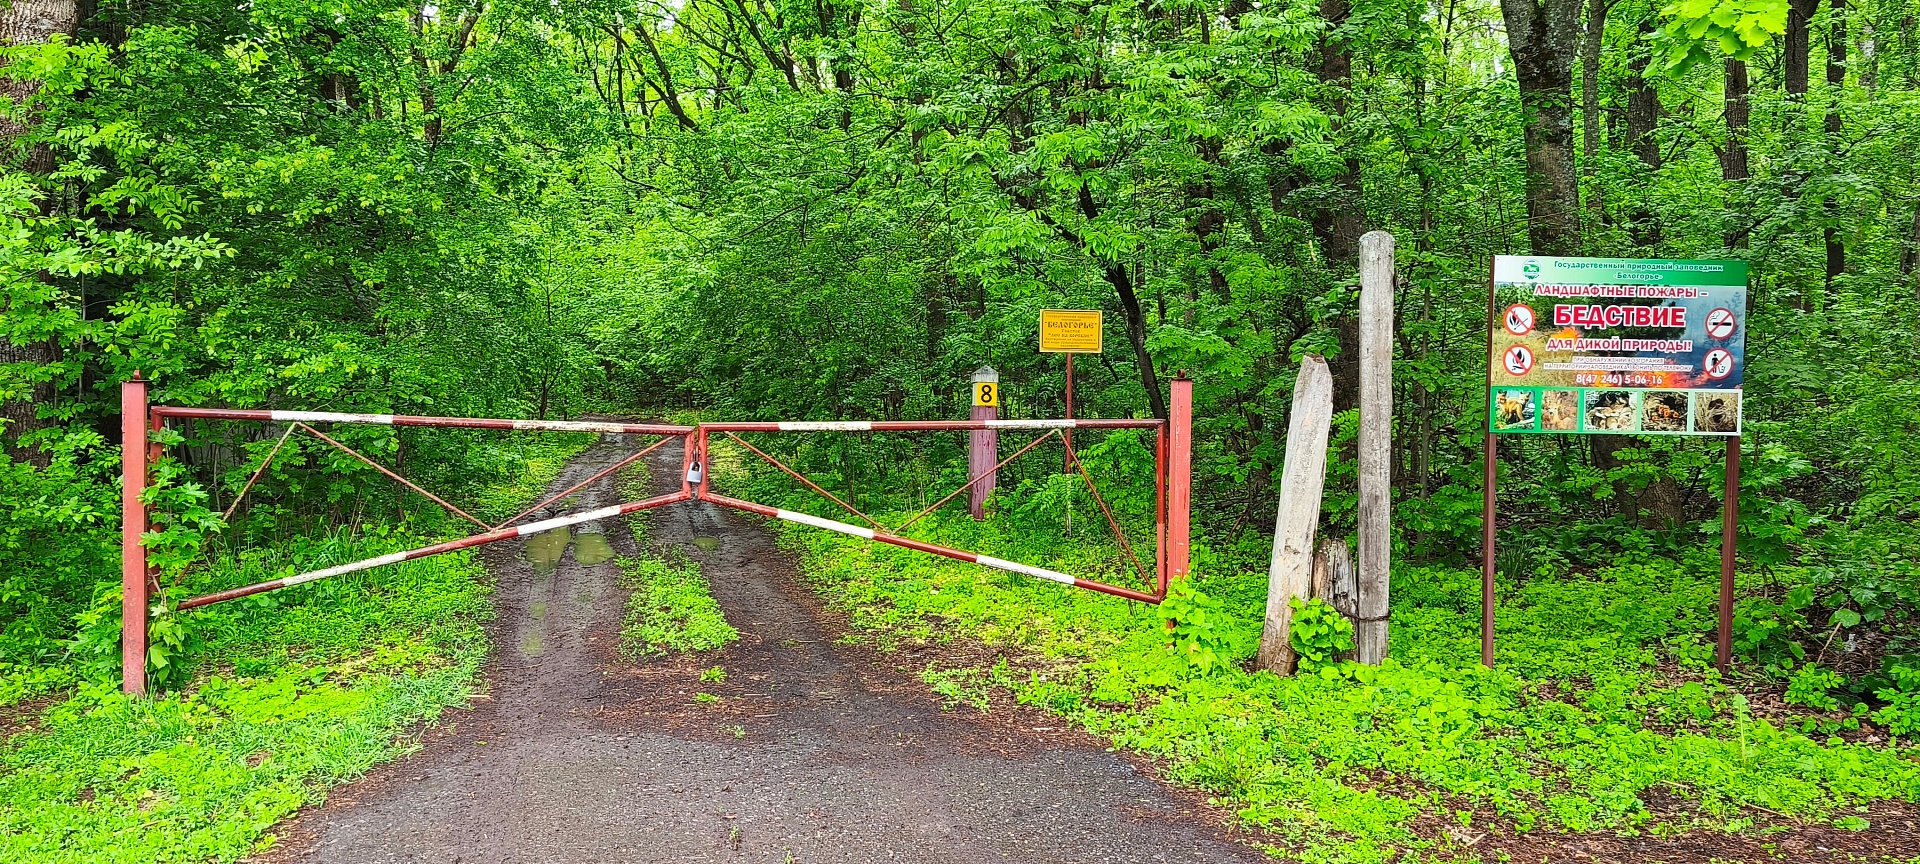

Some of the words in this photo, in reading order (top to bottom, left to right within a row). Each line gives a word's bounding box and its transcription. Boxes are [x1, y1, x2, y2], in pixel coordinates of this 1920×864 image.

[1554, 260, 1625, 269] Государственный
[1627, 262, 1673, 271] природный
[1675, 264, 1723, 272] заповедник
[1535, 285, 1634, 297] ЛАНДШАФТНЫЕ
[1639, 287, 1697, 297] ПОЖАРЫ
[1555, 305, 1685, 328] БЕДСТВИЕ
[1547, 339, 1572, 350] ДЛЯ
[1576, 337, 1620, 350] ДИКОЙ
[1624, 340, 1692, 351] ПРИРОДЫ!
[1576, 373, 1598, 384] 8(47
[1601, 374, 1622, 385] 246)
[1625, 374, 1663, 385] 5-06-16
[981, 384, 992, 403] 8
